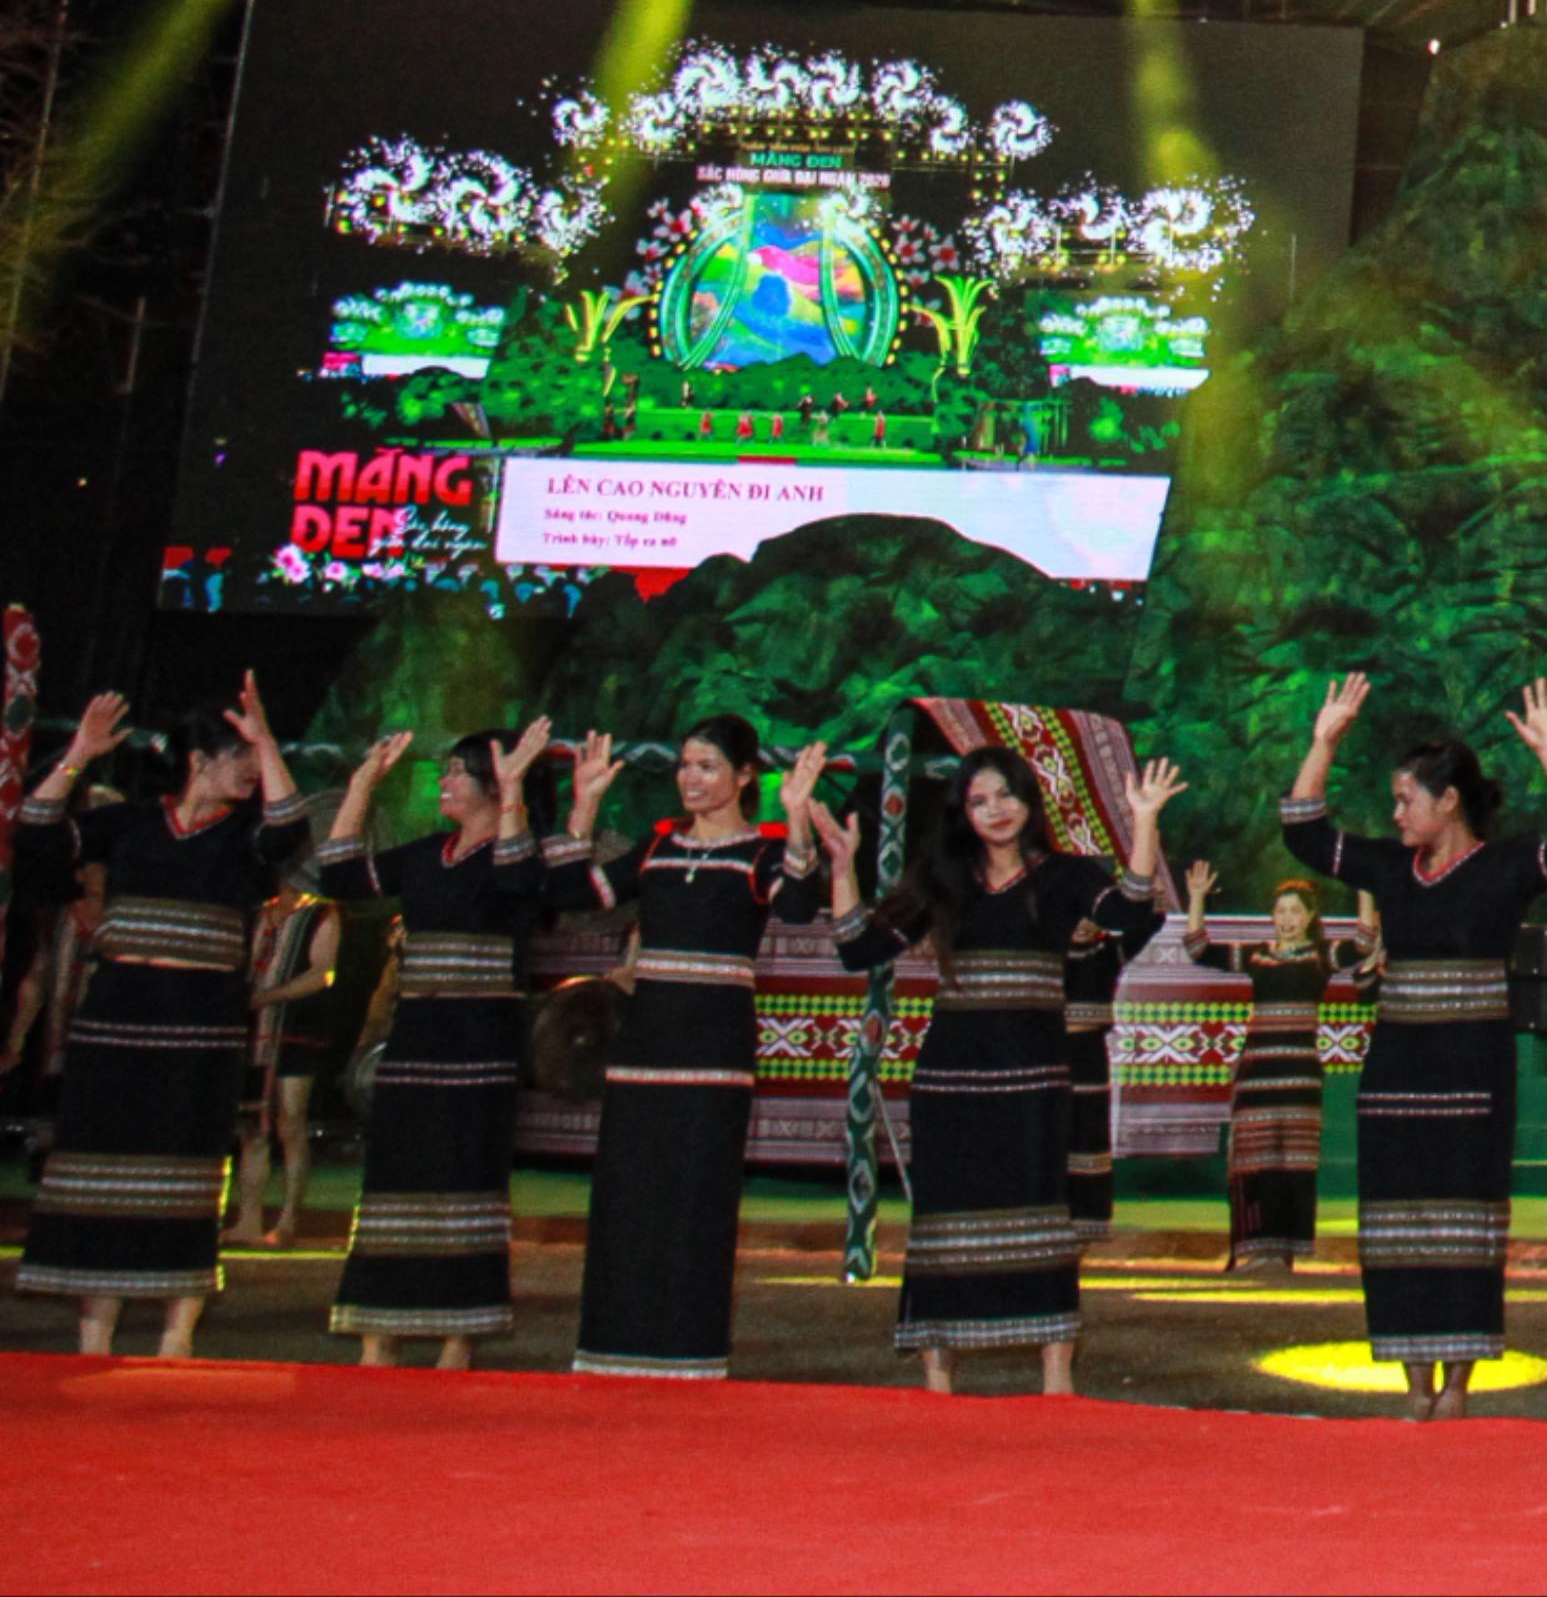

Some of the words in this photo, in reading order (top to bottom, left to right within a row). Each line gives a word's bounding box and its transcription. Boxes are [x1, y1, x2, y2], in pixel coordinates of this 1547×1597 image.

[547, 473, 590, 495] LÊN
[597, 477, 644, 497] CAO
[649, 478, 741, 501] NGUYÊN
[776, 484, 824, 502] ANH
